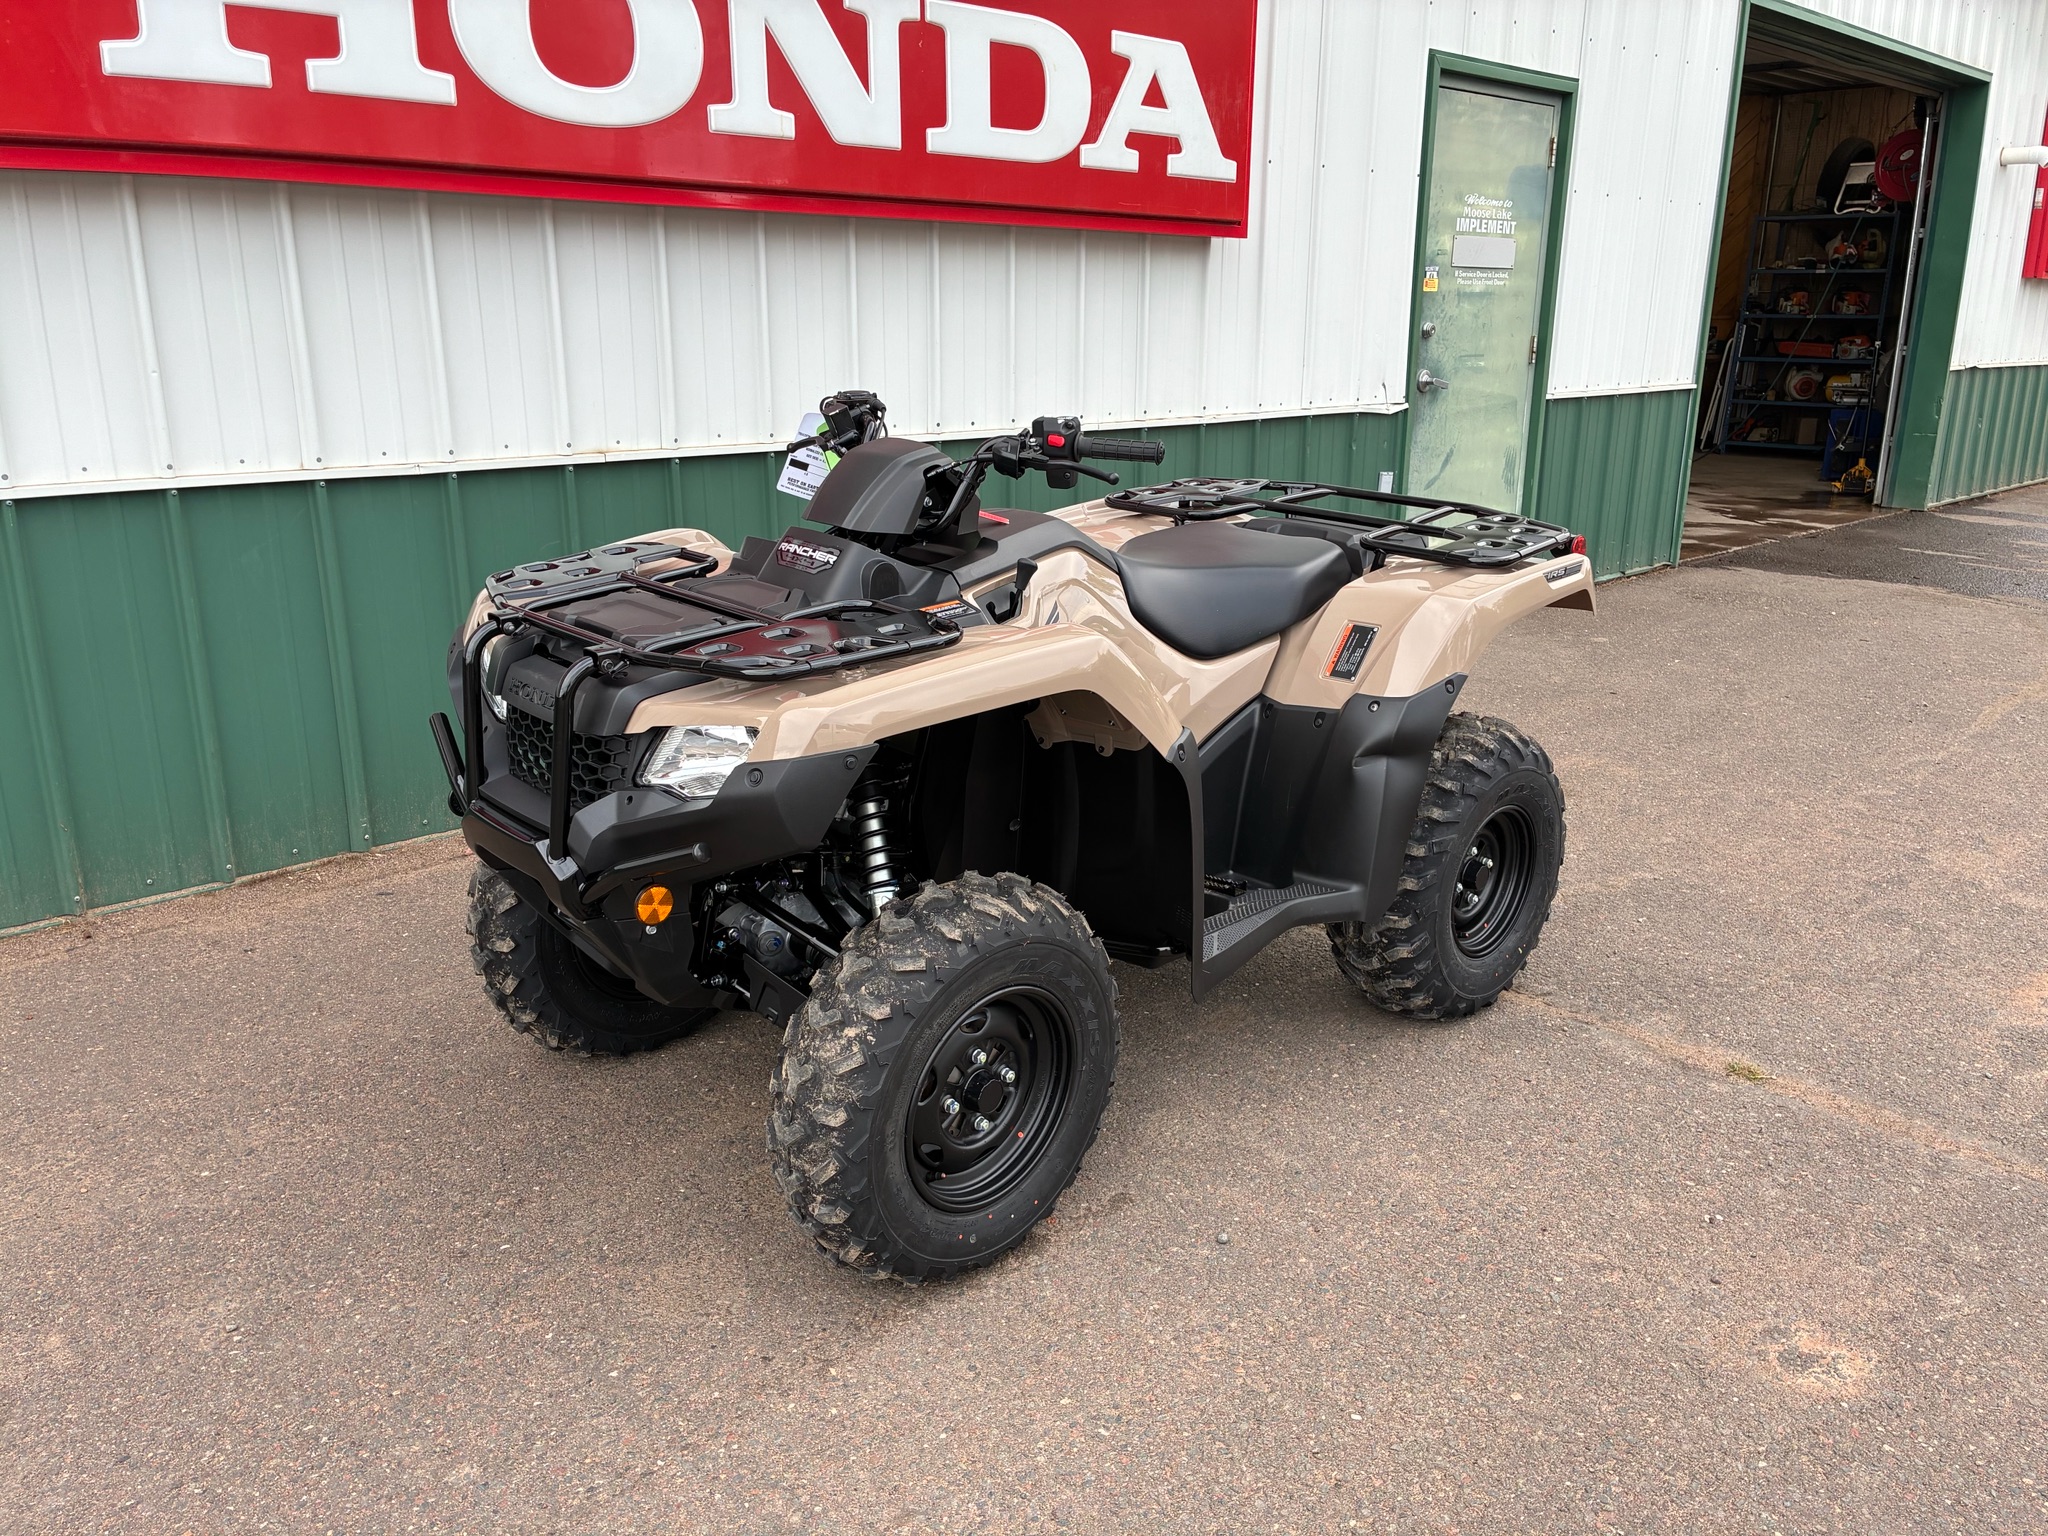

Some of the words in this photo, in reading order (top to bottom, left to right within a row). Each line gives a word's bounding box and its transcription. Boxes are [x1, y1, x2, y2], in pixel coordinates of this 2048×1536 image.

[1465, 193, 1503, 207] Welcome
[1503, 199, 1513, 208] to
[1463, 206, 1491, 219] Moose
[1492, 208, 1513, 220] Lake
[1456, 218, 1517, 234] IMPLEMENT
[1459, 270, 1476, 278] Service
[779, 542, 838, 565] RANCHER
[1547, 568, 1566, 580] IRS
[509, 677, 555, 711] HOND
